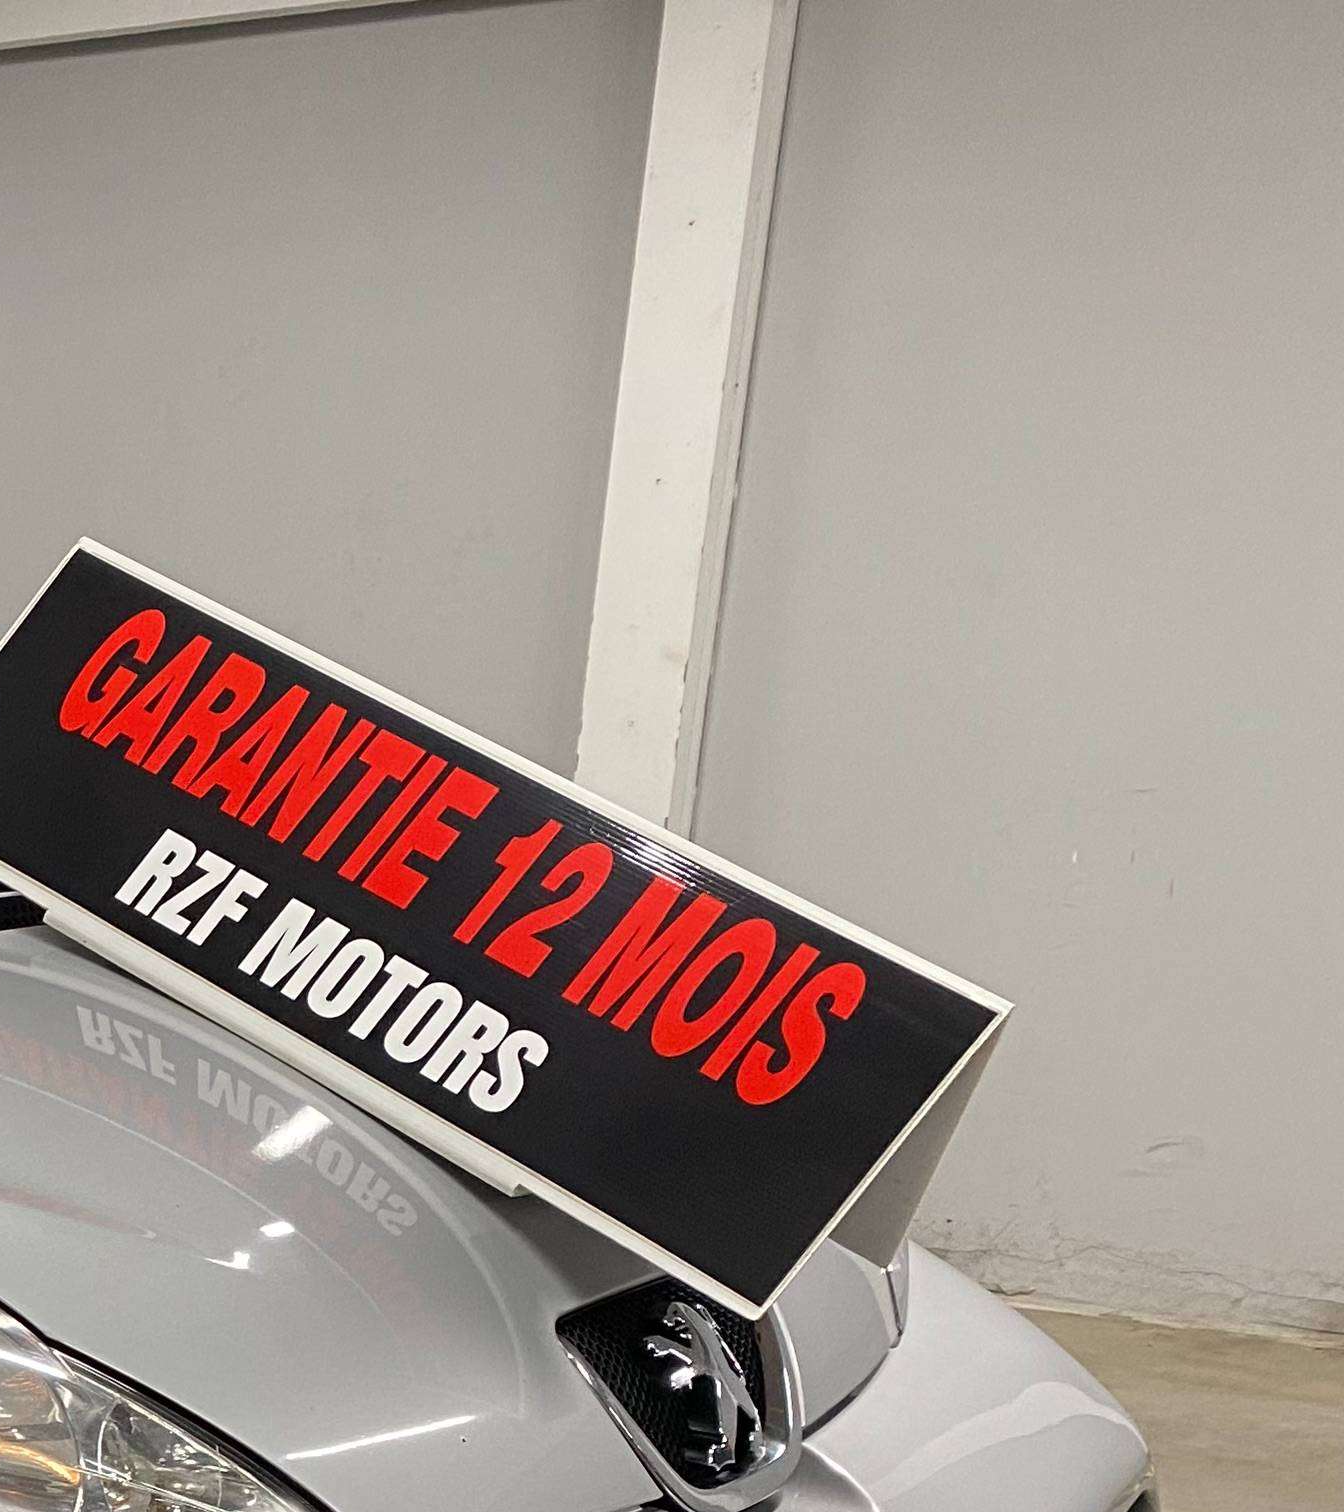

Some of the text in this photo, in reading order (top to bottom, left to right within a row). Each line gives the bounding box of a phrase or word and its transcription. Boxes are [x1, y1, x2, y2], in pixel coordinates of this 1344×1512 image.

[57, 609, 867, 1105] GARANTIE 12 MOIS
[113, 828, 271, 946] RZF
[239, 905, 549, 1114] MOTORS
